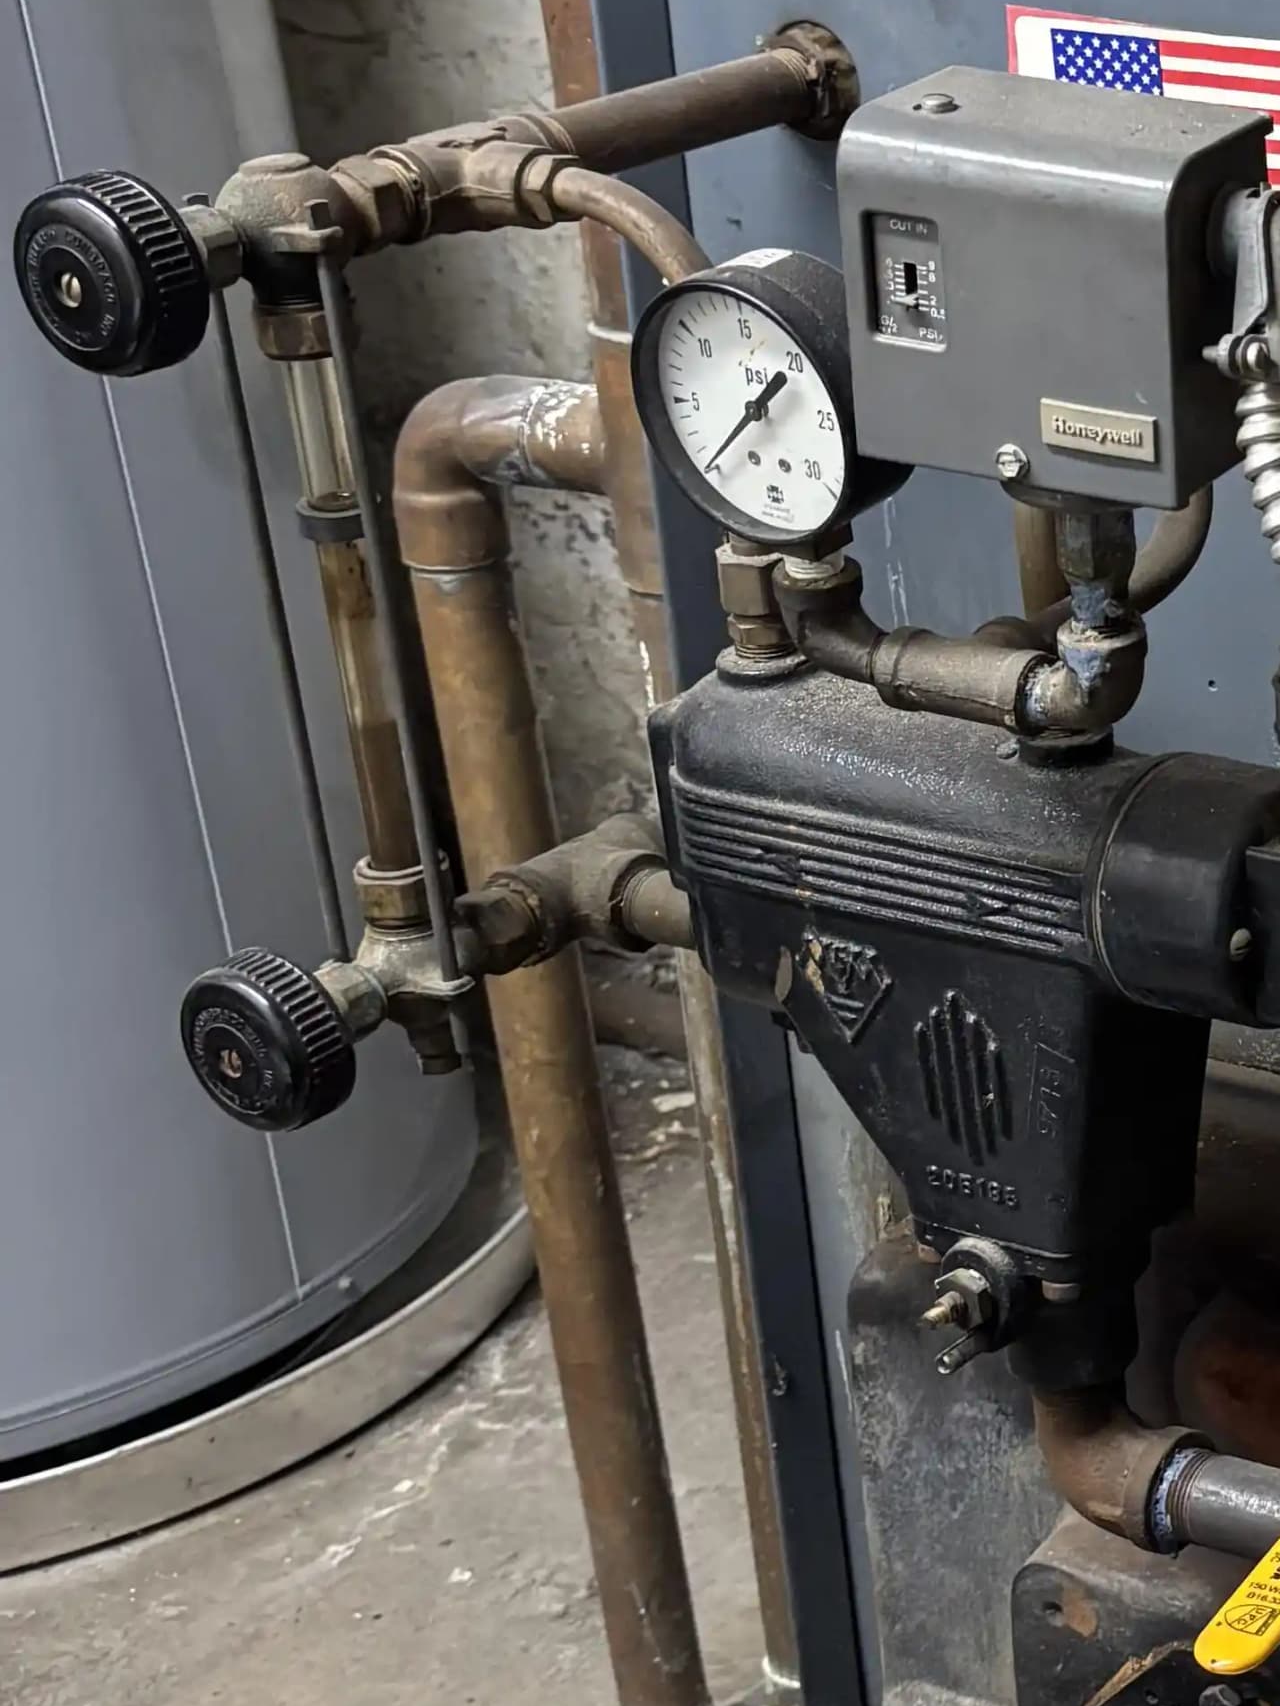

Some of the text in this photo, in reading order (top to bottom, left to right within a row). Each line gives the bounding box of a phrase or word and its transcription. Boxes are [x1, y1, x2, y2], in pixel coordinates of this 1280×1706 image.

[737, 317, 752, 340] 15
[698, 337, 712, 359] 10
[786, 351, 804, 374] 20
[745, 364, 767, 386] psi
[691, 391, 700, 412] 5
[817, 409, 835, 431] 25
[1051, 414, 1143, 447] Honeywell
[804, 458, 821, 481] 30
